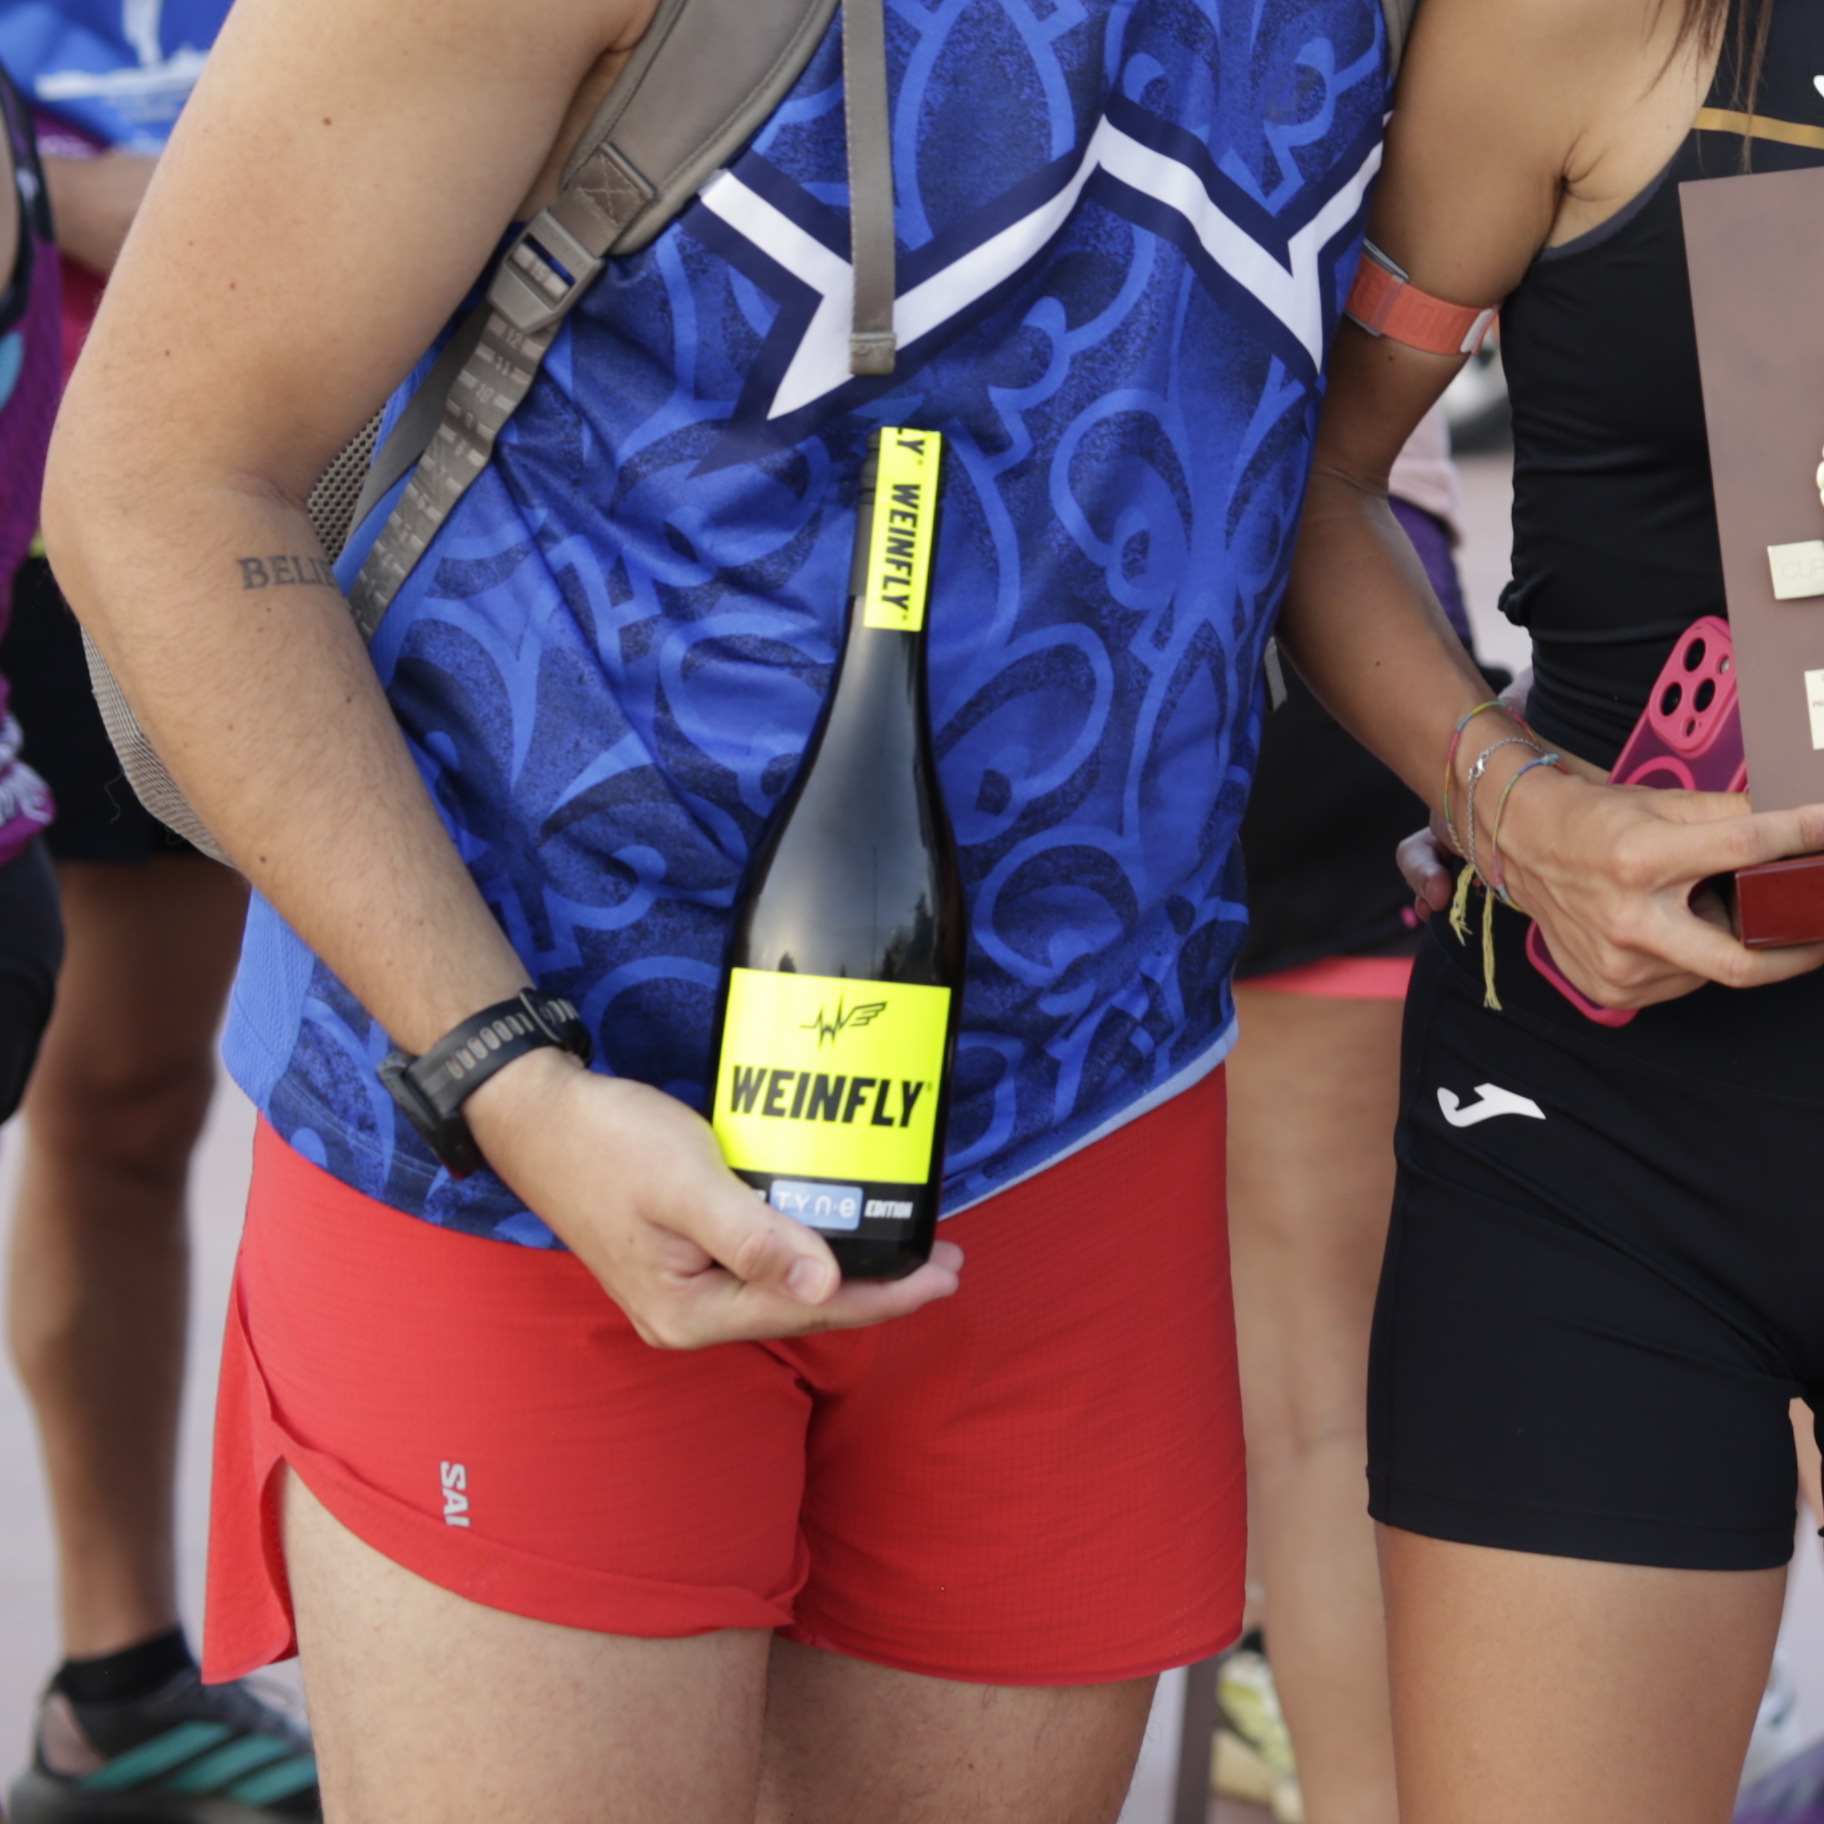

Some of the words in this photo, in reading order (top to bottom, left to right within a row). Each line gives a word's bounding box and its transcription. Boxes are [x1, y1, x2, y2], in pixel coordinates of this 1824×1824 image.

[881, 483, 921, 612] WEINFLY
[730, 1064, 925, 1128] WEINFLY
[865, 1198, 914, 1220] EDITION
